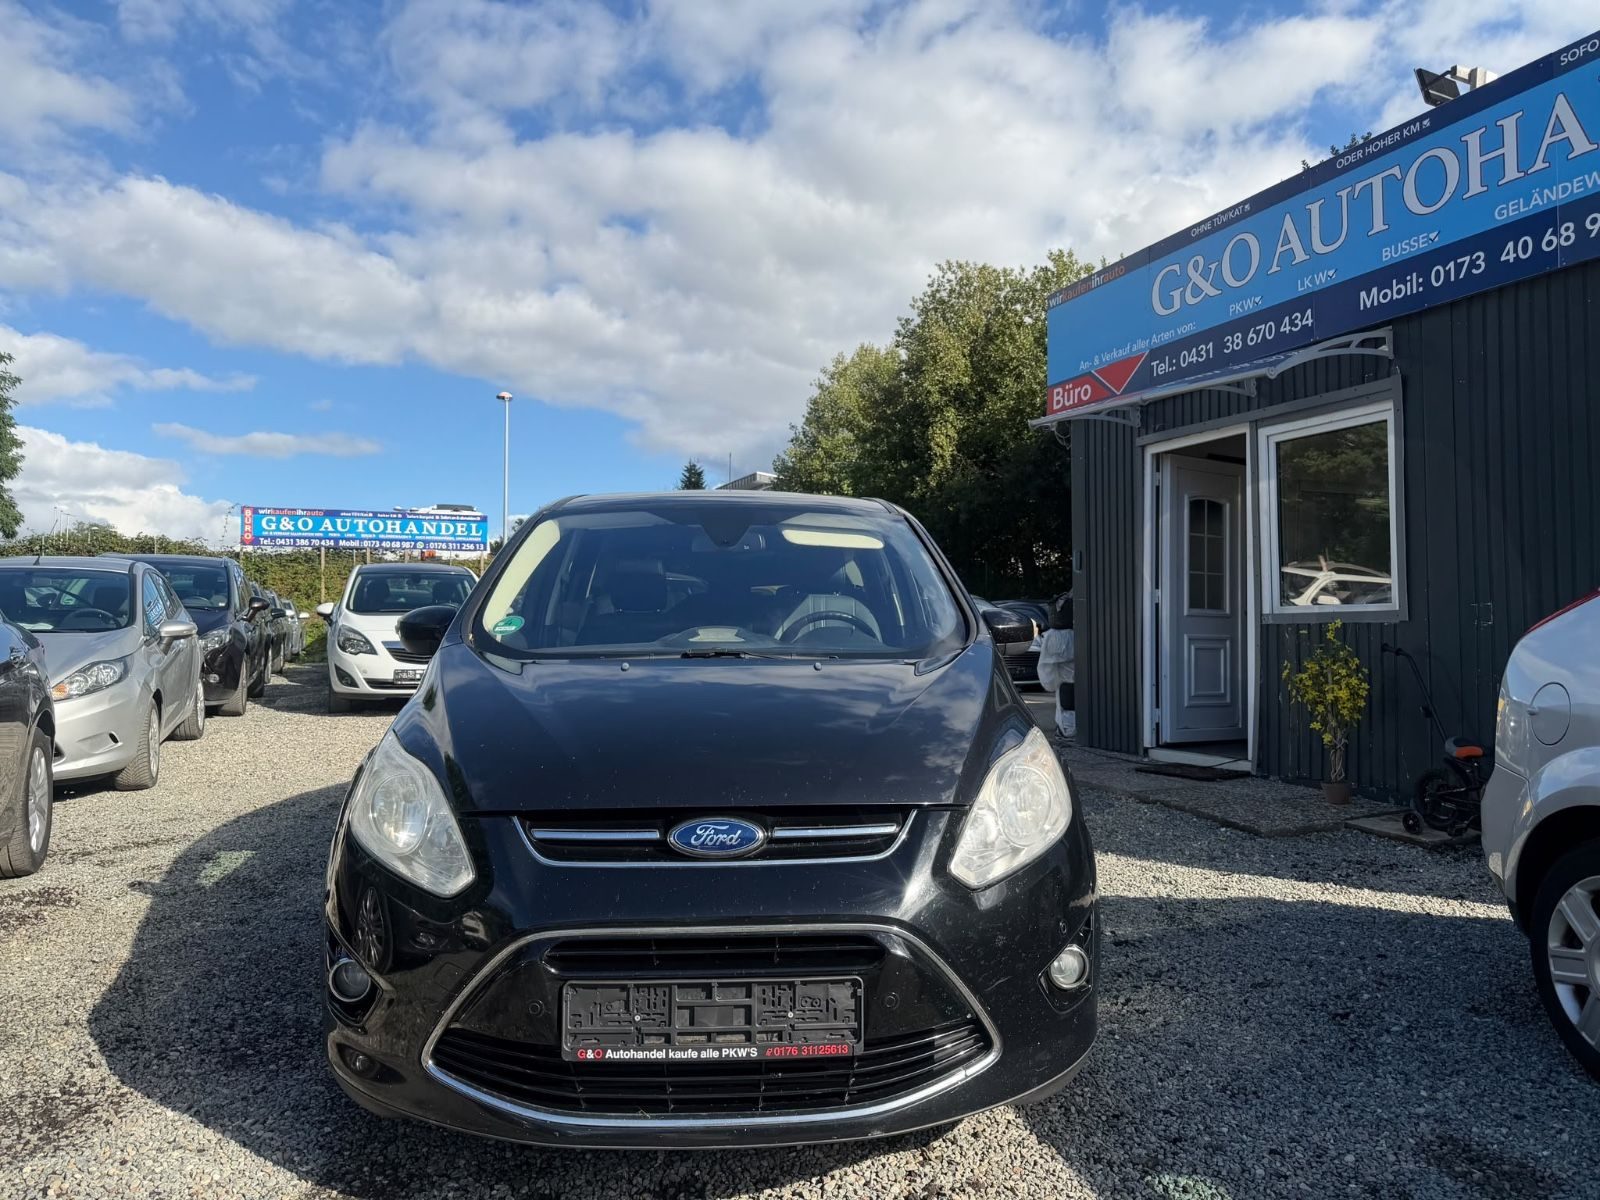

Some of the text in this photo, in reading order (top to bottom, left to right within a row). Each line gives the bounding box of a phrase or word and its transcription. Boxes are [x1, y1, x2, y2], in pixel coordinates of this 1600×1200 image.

[1560, 39, 1600, 66] SOFO
[1335, 121, 1421, 170] ODER HOHER KM
[1151, 91, 1600, 317] G&O AUTOHA
[1494, 170, 1600, 221] GELÄNDEW
[1190, 221, 1212, 238] OHNE
[1358, 212, 1600, 311] Mobil: 0173 40 68 9
[1381, 232, 1430, 262] BUSSE
[1048, 264, 1126, 308] wirkaufenihrauto
[1229, 296, 1255, 317] PKW
[1079, 321, 1197, 371] An- & Verkauf aller Arten von:
[1151, 355, 1177, 377] Tel.:
[1180, 341, 1214, 368] 0431
[1222, 331, 1243, 354] 38
[1246, 321, 1276, 346] 670
[1279, 308, 1314, 334] 434
[1052, 380, 1092, 411] Büro
[258, 508, 324, 516] wirkaufenihrauto
[261, 516, 483, 536] G&O AUTOHANDEL
[259, 537, 275, 545] Tel.:
[275, 538, 294, 546] 0431
[295, 538, 310, 546] 386
[310, 538, 320, 546] 70
[320, 538, 335, 546] 434
[381, 540, 391, 548] 40
[391, 540, 401, 548] 68
[401, 541, 415, 549] 987
[447, 542, 460, 550] 311
[690, 824, 742, 846] Ford
[577, 1044, 849, 1059] G&O Autohandel kaufe alle PKW'S 0176 31125613
